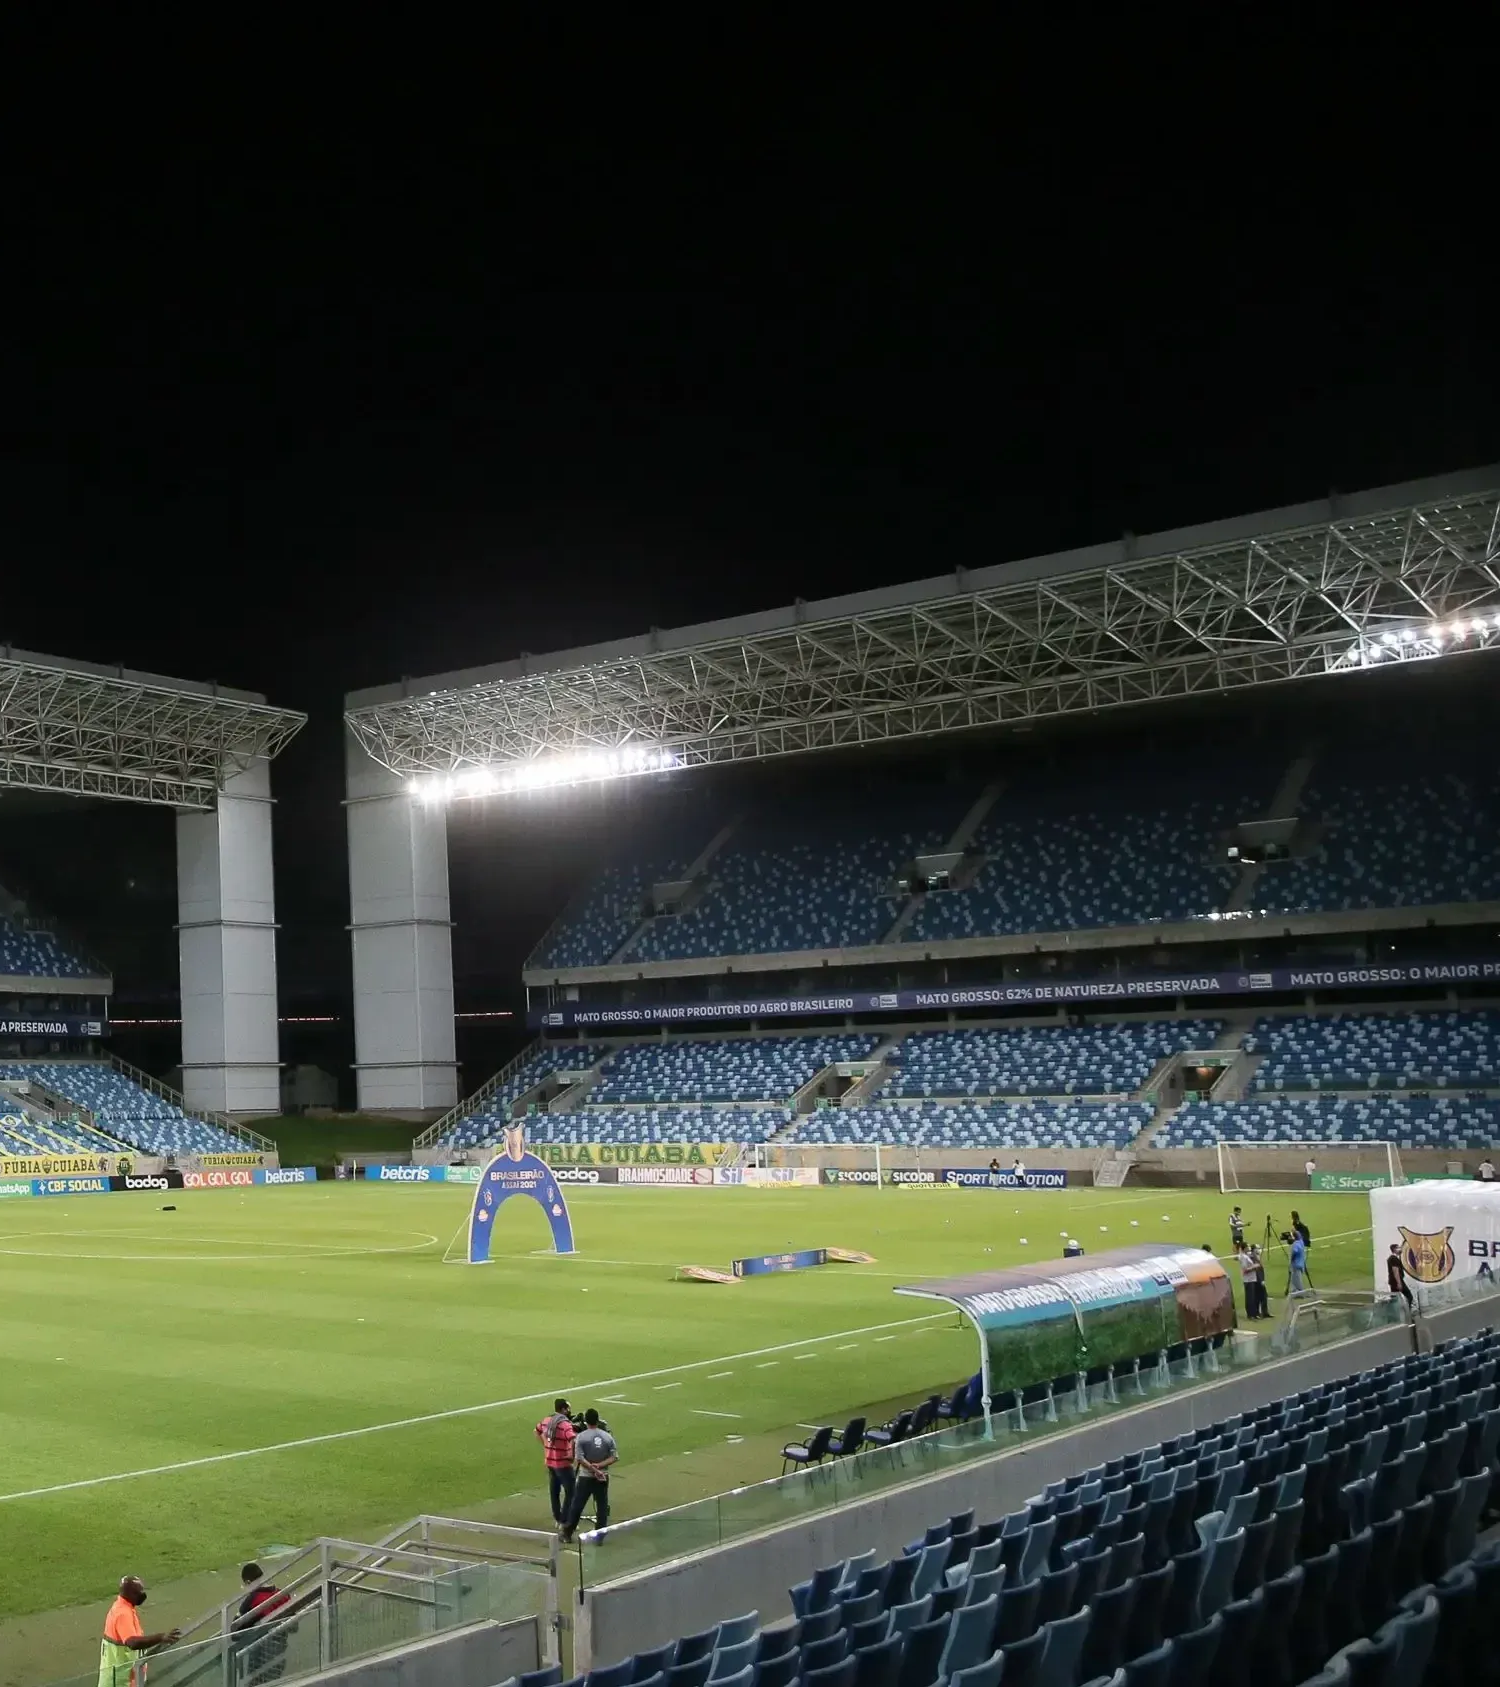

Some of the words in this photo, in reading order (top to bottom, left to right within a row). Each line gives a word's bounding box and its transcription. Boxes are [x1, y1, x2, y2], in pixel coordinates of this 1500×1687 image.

[1290, 972, 1334, 986] MATO
[1337, 969, 1406, 983] GROSSO:
[1409, 967, 1421, 979] O
[1424, 965, 1479, 979] MAIOR
[916, 992, 949, 1005] MATO
[951, 990, 1004, 1003] GROSSO:
[1006, 988, 1032, 1000] 62%
[1035, 987, 1052, 998] DE
[1055, 983, 1123, 997] NATUREZA
[1127, 977, 1220, 994] PRESERVADA
[574, 1012, 600, 1023] MATO
[602, 1009, 643, 1021] GROSSO:
[644, 1008, 652, 1019] O
[653, 1007, 685, 1018] MAIOR
[687, 1004, 741, 1017] PRODUTOR
[743, 1003, 758, 1014] DO
[759, 1002, 788, 1013] AGRO
[790, 998, 853, 1012] BRASILEIRO
[9, 1022, 68, 1034] PRESERVADA
[184, 1173, 207, 1186] GOL
[208, 1172, 230, 1185] GOL
[230, 1171, 252, 1184] GOL
[265, 1169, 305, 1184] betcris
[380, 1166, 430, 1181] betcris
[491, 1168, 544, 1180] BRASILEIRÃO
[618, 1168, 693, 1183] BRAHMOSIDADE
[720, 1168, 743, 1183] Sil
[838, 1171, 878, 1182] SICOOB
[892, 1172, 935, 1182] SICOOB
[48, 1180, 67, 1192] CBF
[69, 1178, 104, 1191] SOCIAL
[125, 1176, 169, 1189] bodog
[520, 1180, 536, 1189] 2021
[1339, 1176, 1385, 1188] Sicredi
